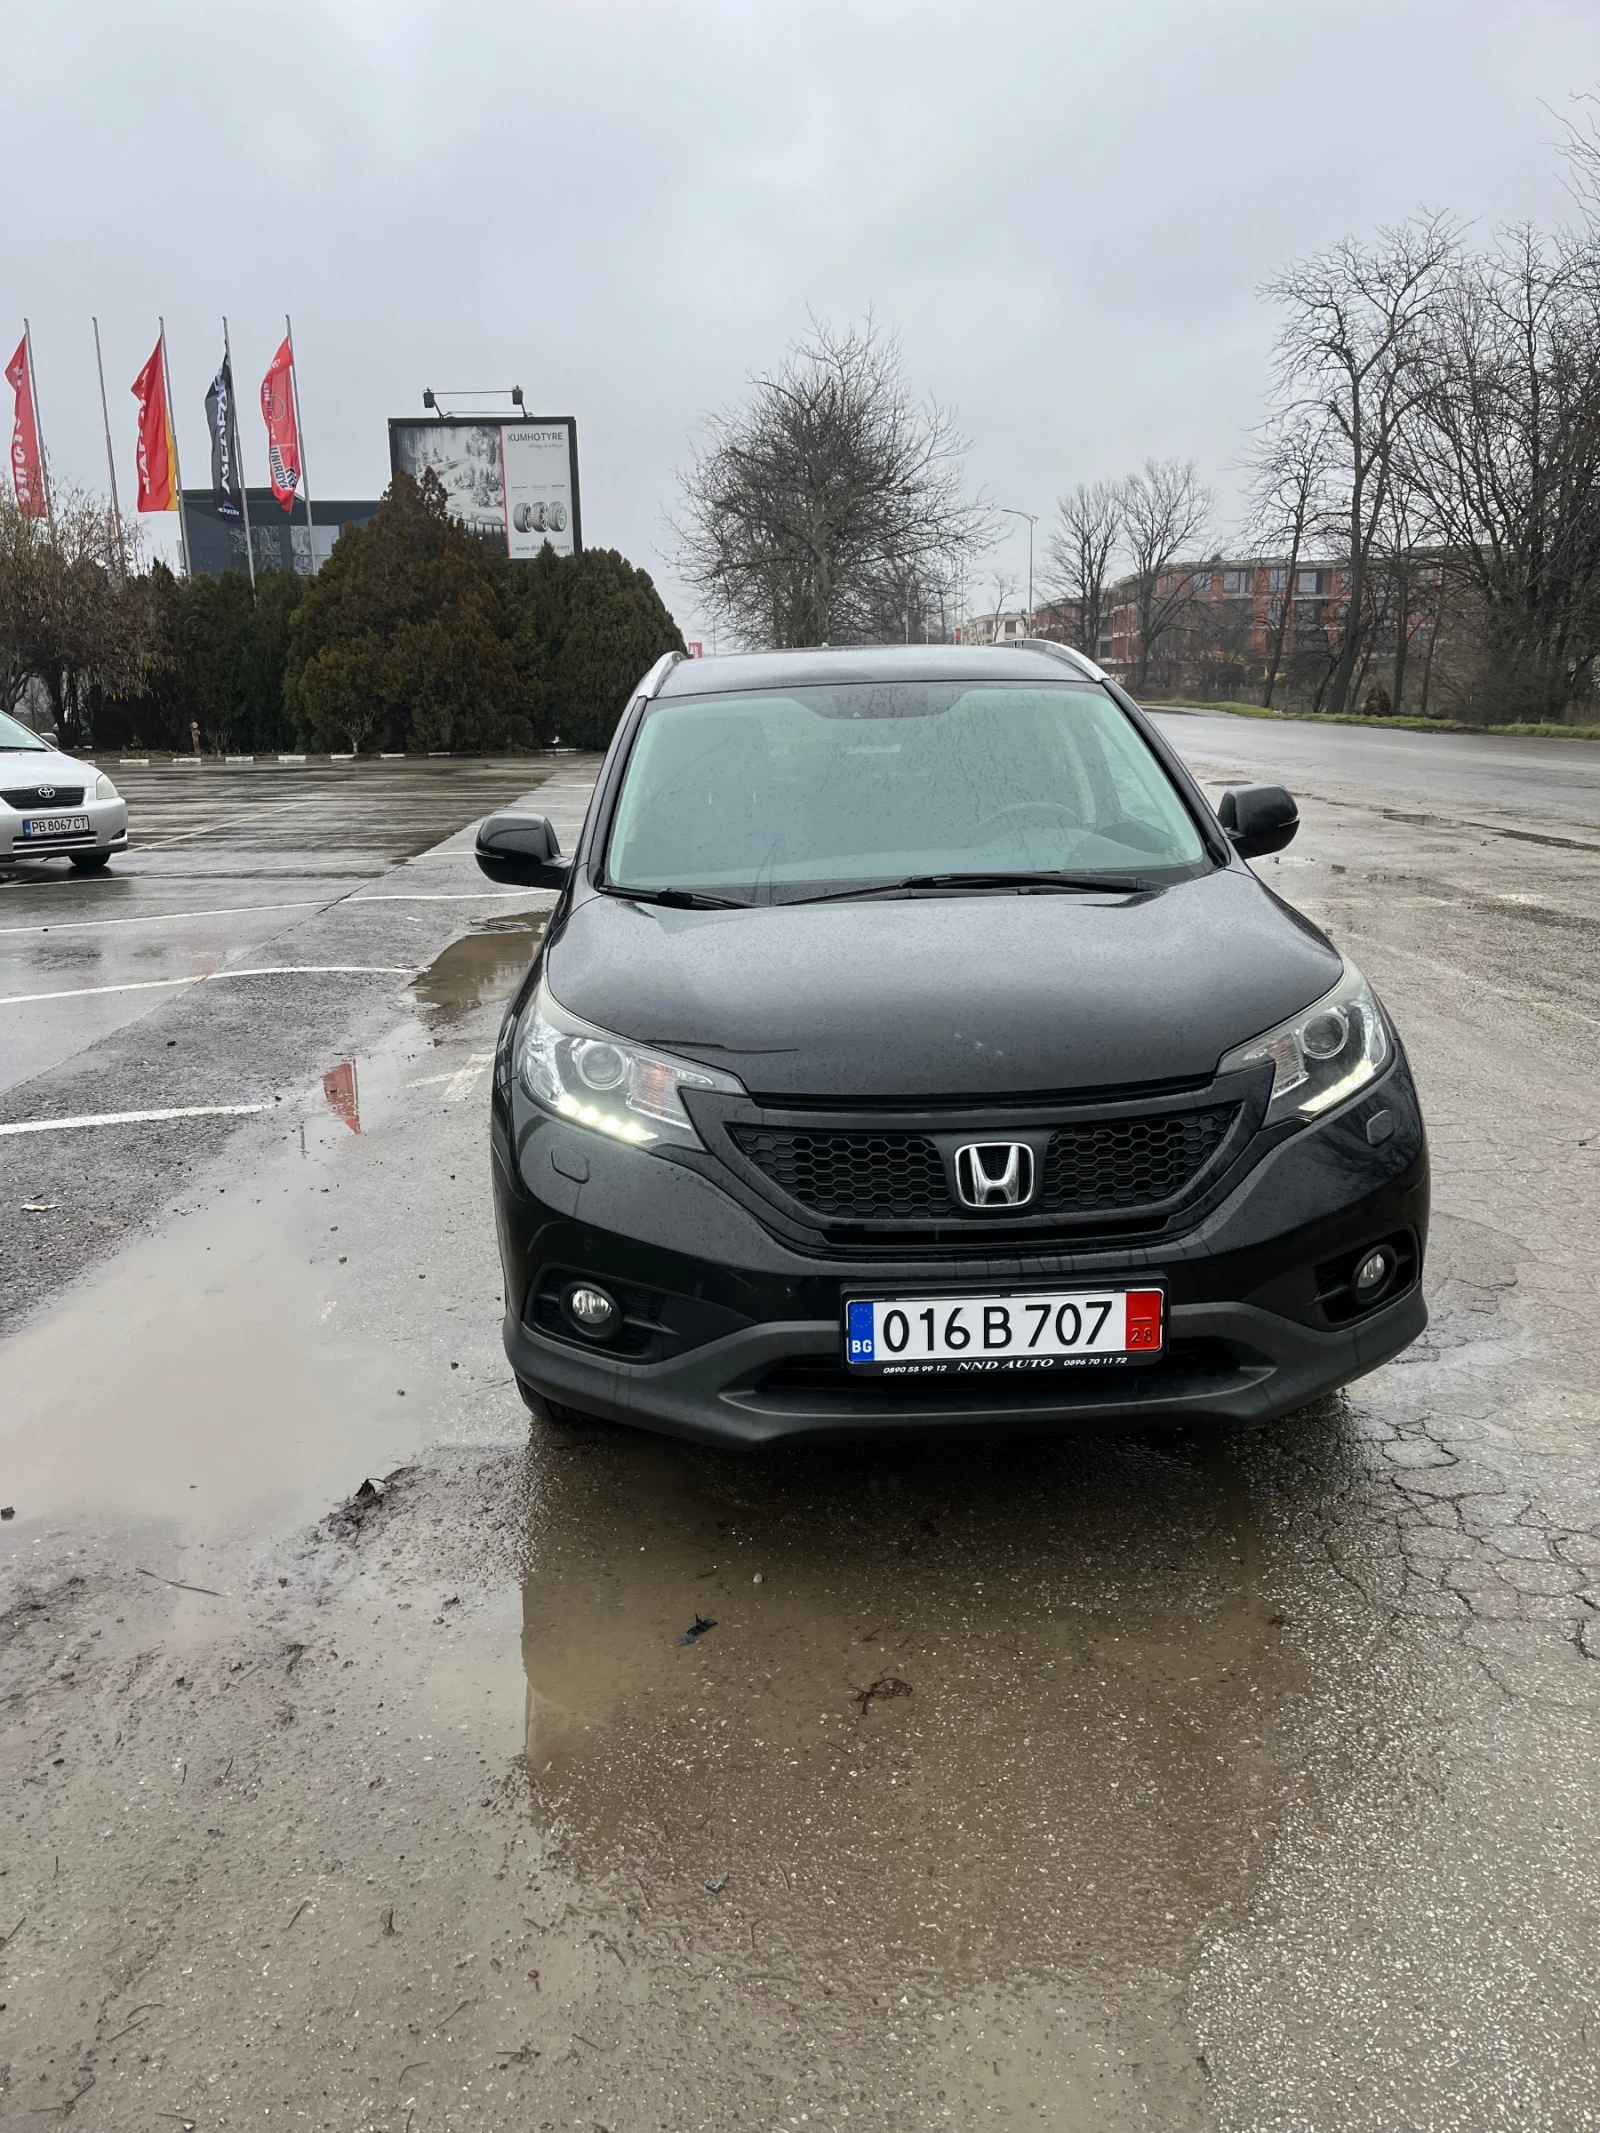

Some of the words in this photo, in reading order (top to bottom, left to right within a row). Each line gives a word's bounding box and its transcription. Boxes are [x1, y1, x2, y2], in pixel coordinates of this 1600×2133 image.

[270, 446, 289, 490] UNIROYA
[32, 821, 46, 832] PB
[48, 819, 71, 831] 8067
[74, 818, 86, 829] CT
[883, 1307, 971, 1353] 016
[984, 1306, 1012, 1349] B
[1025, 1301, 1112, 1348] 707
[1131, 1327, 1153, 1344] 28
[851, 1339, 873, 1354] BG
[957, 1361, 999, 1371] NND
[1001, 1358, 1054, 1369] AUTO
[1063, 1358, 1086, 1366] 0896
[1115, 1356, 1128, 1364] 72
[883, 1366, 906, 1374] 0890
[921, 1365, 933, 1373] 99
[936, 1364, 948, 1372] 12
